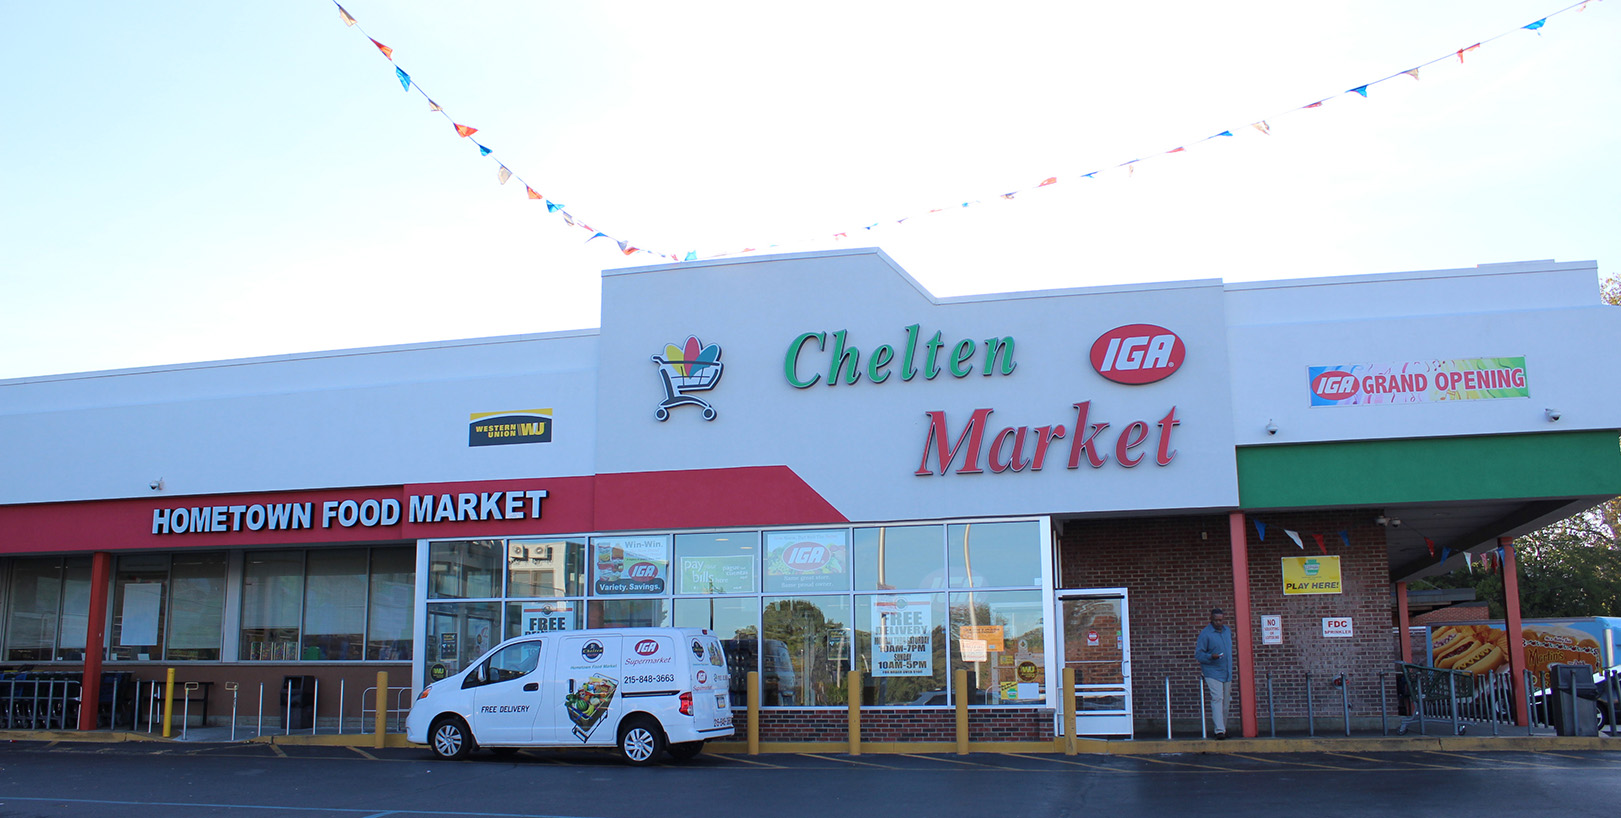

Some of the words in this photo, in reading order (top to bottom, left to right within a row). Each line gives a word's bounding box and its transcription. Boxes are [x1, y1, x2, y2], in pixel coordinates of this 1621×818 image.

[783, 323, 1017, 389] Chelten
[1100, 334, 1176, 371] IGA
[1316, 376, 1355, 395] IGA
[1361, 373, 1428, 395] GRAND
[1434, 368, 1525, 391] OPENING
[475, 424, 516, 433] WESTERN
[487, 430, 516, 438] UNION
[520, 422, 545, 436] WU
[914, 400, 1181, 476] Market
[151, 502, 312, 535] HOMETOWN
[322, 498, 402, 529] FOOD
[408, 489, 548, 523] MARKET
[625, 540, 663, 548] Win-Win.
[787, 546, 825, 564] IGA
[631, 565, 655, 577] IGA
[684, 560, 704, 572] pay
[692, 570, 714, 583] bills
[599, 583, 628, 592] Variety.
[629, 583, 661, 591] Savings.
[1286, 582, 1309, 590] PLAY
[529, 617, 566, 631] FREE
[1327, 620, 1348, 628] FDC
[637, 641, 657, 653] IGA
[624, 656, 672, 667] Supermarket
[878, 661, 927, 669] 10AM-5PM
[624, 673, 675, 684] 215-848-3663
[499, 705, 530, 713] DELIVERY
